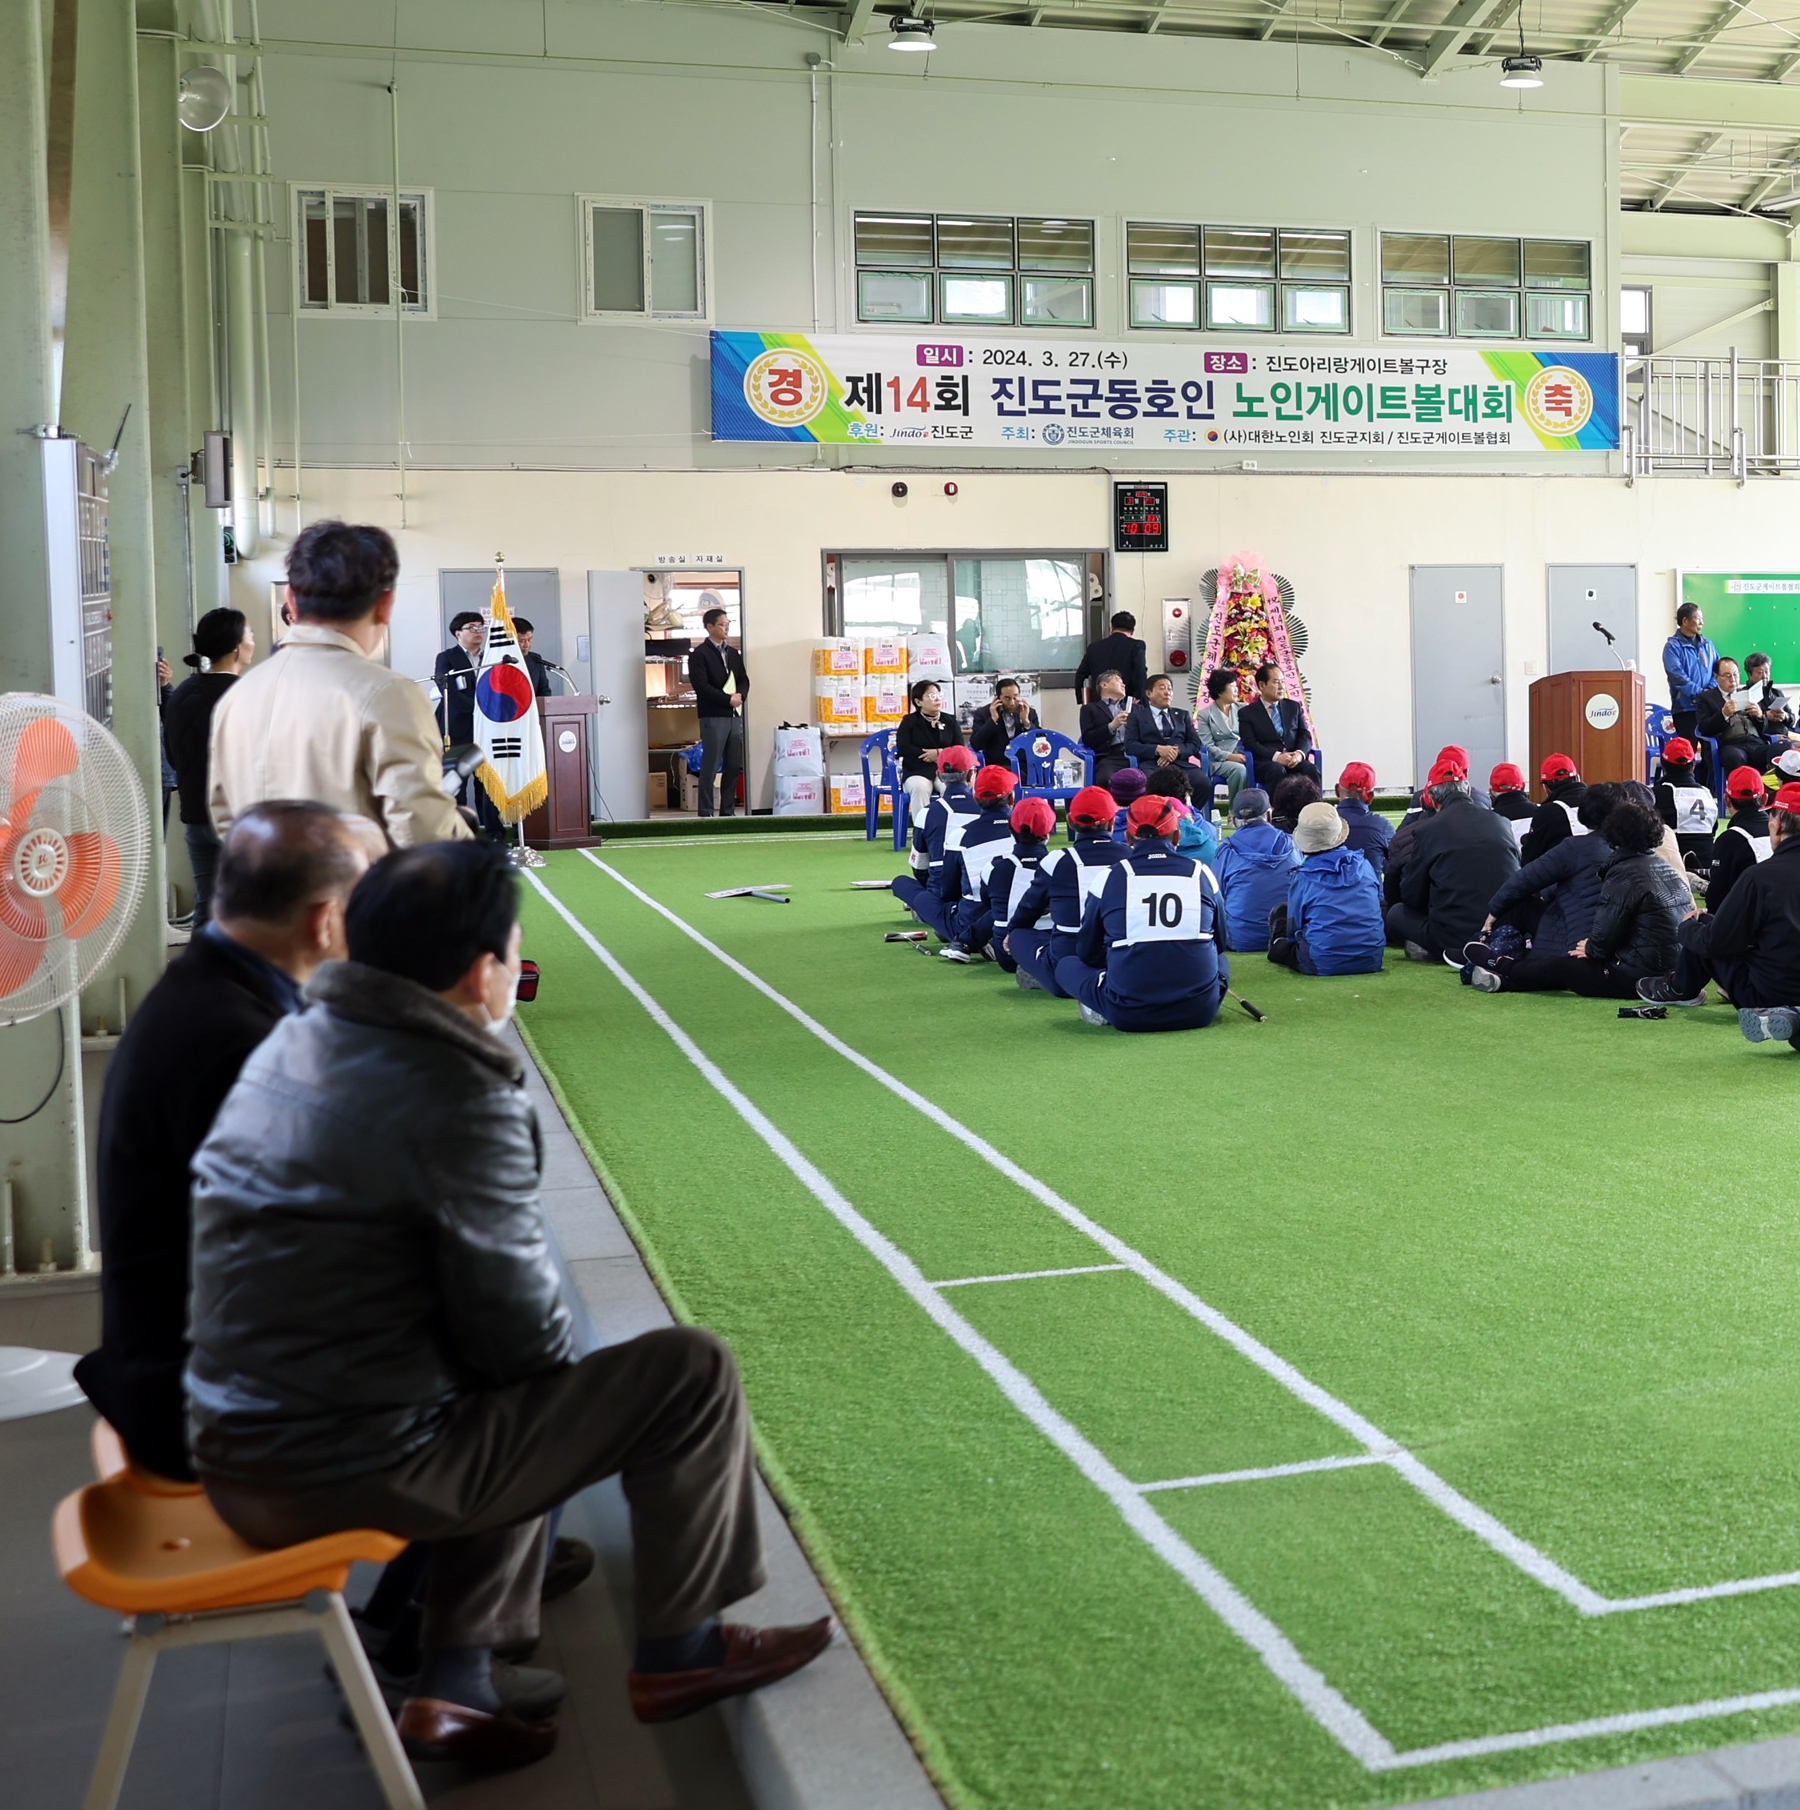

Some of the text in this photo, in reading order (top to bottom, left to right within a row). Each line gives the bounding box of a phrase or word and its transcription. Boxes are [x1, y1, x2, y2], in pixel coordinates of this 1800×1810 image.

[923, 347, 957, 365] 일시
[982, 349, 1032, 367] 2024.
[1042, 351, 1059, 367] 3.
[1068, 350, 1128, 369] 27.(수)
[1210, 354, 1242, 371] 장소
[1265, 356, 1448, 375] 진도아리랑게이트볼구장
[768, 368, 803, 406] 경
[844, 373, 1513, 423] 제14회 진도군동호인 노인게이트볼대회
[1544, 383, 1573, 418] 축
[931, 425, 974, 439] 진도군
[1066, 426, 1134, 439] 진도군체육회
[1223, 429, 1314, 444] (사)대한노인회
[1320, 430, 1384, 445] 진도군지회
[1397, 431, 1511, 445] 진도군게이트볼협회
[1690, 799, 1707, 820] 4
[1141, 892, 1183, 928] 10
